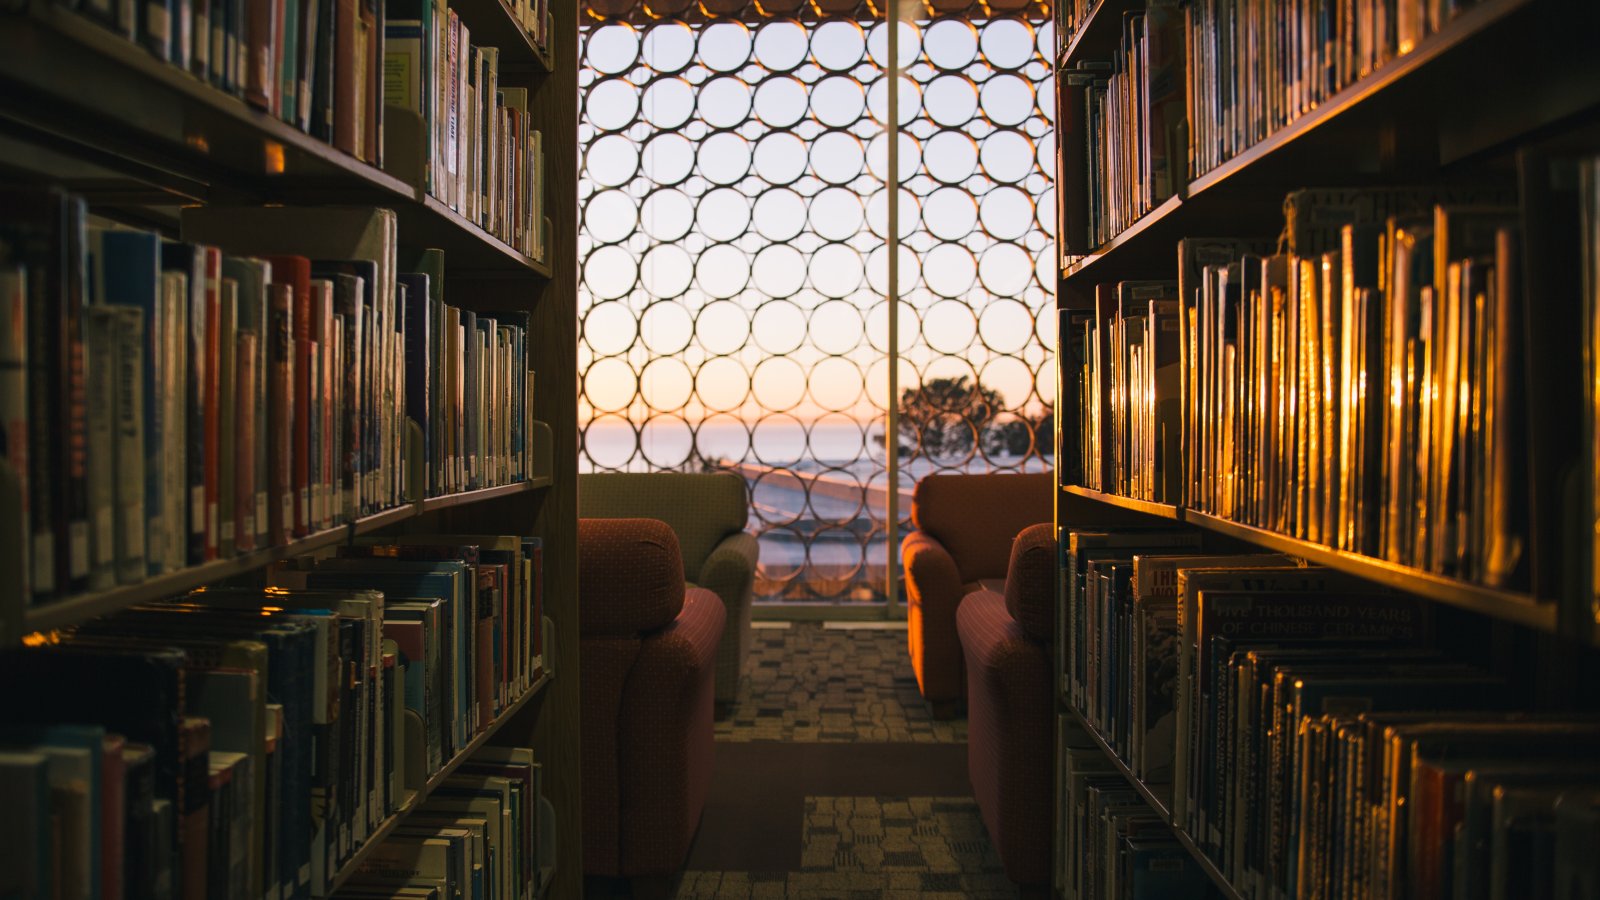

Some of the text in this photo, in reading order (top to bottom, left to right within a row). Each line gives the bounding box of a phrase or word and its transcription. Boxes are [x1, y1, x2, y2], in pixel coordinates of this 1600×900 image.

[1217, 605, 1412, 623] FIVE THOUSAND YEARS
[1222, 622, 1414, 638] OF CHINESE CERAMICS
